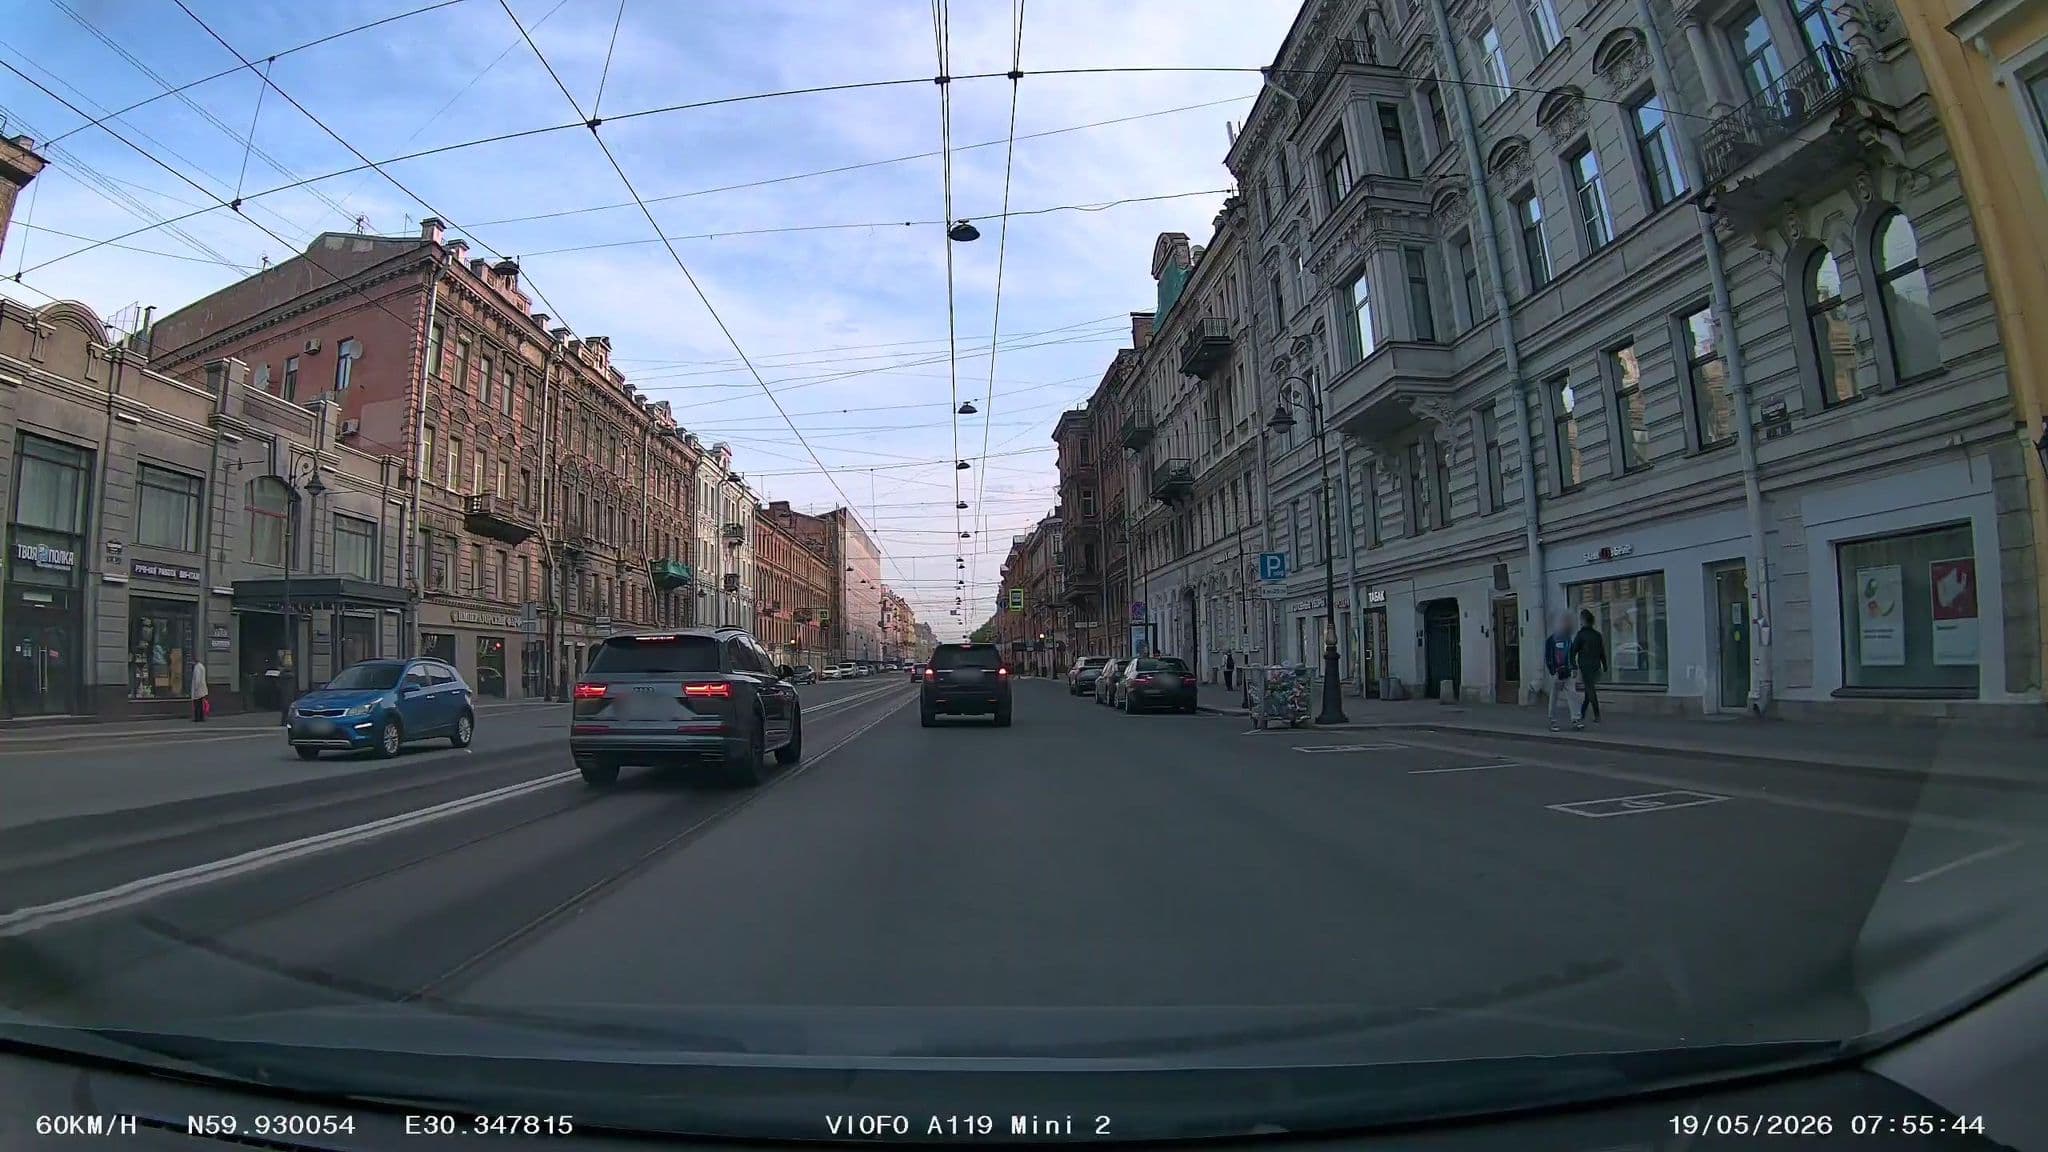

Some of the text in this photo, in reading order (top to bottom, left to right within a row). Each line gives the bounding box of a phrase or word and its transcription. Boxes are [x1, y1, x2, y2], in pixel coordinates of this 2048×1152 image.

[17, 543, 75, 565] ТВОЯ ПОЛКА
[1266, 555, 1281, 577] P
[1368, 590, 1386, 603] ТАБАК
